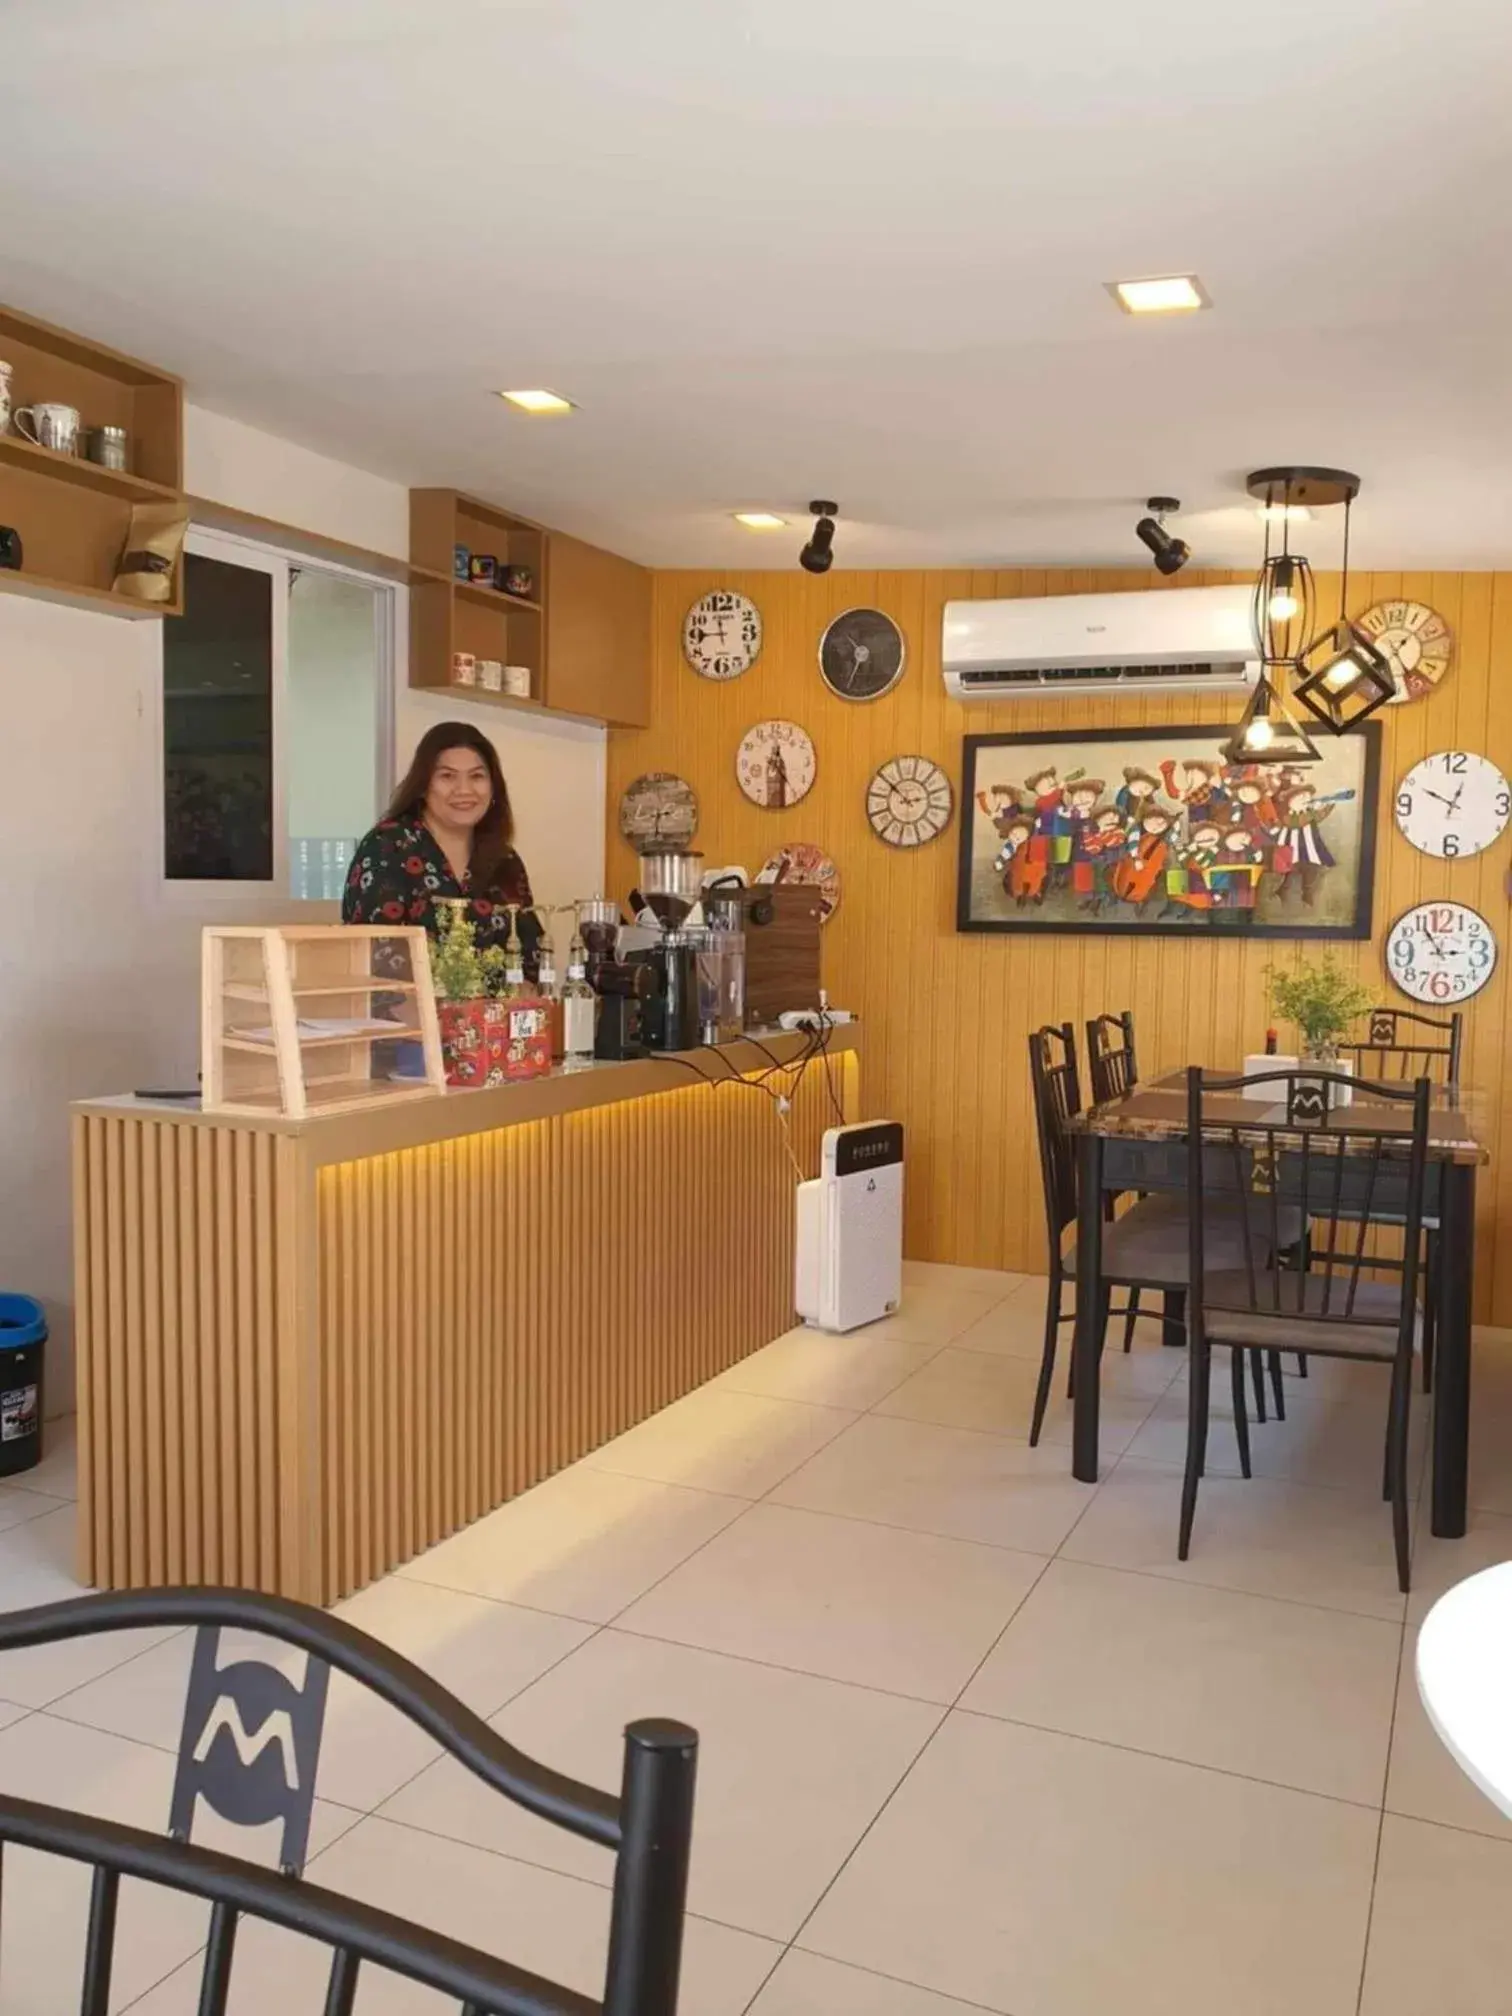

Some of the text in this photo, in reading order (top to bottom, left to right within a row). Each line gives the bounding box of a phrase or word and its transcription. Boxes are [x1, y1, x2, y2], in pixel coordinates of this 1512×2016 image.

[712, 595, 733, 612] 12
[692, 615, 707, 626] 10
[742, 610, 753, 622] 2
[1369, 614, 1383, 630] 11
[1389, 608, 1402, 622] 12
[689, 628, 704, 645] 9
[742, 624, 757, 641] 3
[714, 657, 730, 674] 6
[1441, 752, 1468, 774] 12
[1396, 793, 1412, 817] 9
[1494, 793, 1510, 816] 3
[1443, 834, 1460, 857] 6
[1429, 908, 1454, 934] 12
[1458, 914, 1464, 932] 1
[1401, 926, 1415, 938] 10
[1468, 923, 1480, 938] 2
[1393, 940, 1415, 968] 9
[1468, 939, 1489, 968] 3
[1403, 967, 1417, 982] 8
[1419, 970, 1430, 992] 7
[1466, 967, 1479, 982] 4
[1430, 972, 1451, 998] 6
[1453, 974, 1466, 993] 5
[192, 1694, 300, 1791] M
